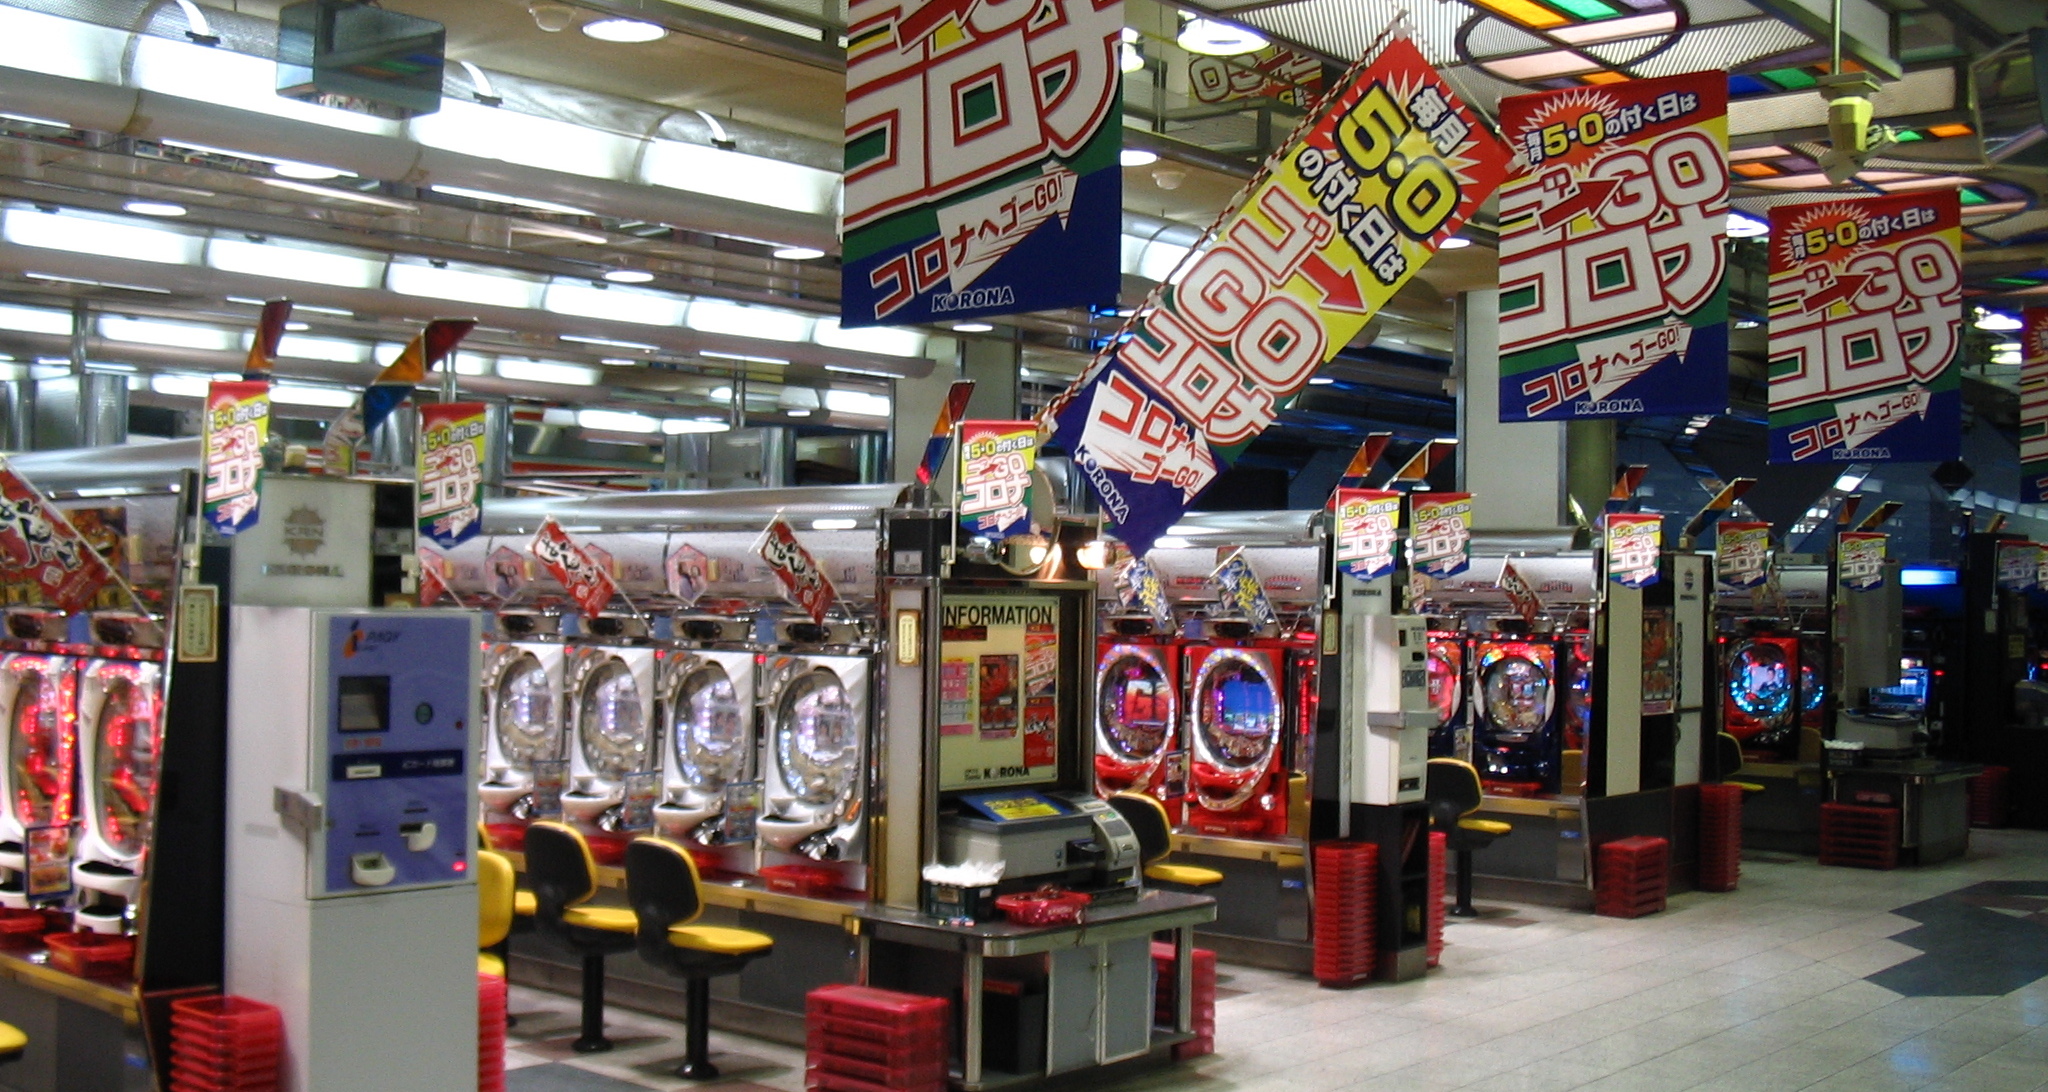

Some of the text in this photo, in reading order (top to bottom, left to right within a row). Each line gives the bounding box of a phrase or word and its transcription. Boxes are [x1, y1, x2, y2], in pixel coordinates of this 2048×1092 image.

[1407, 84, 1471, 157] 毎月
[1297, 147, 1406, 284] の付く日は
[931, 286, 1016, 312] KORONA
[1176, 245, 1327, 390] GO
[1499, 203, 1730, 353] コロナ
[1118, 307, 1278, 443] コロナ
[1768, 296, 1962, 410] コロナ
[1574, 400, 1644, 415] KORONA
[961, 473, 1033, 515] コロナ
[1074, 443, 1130, 525] KORONA
